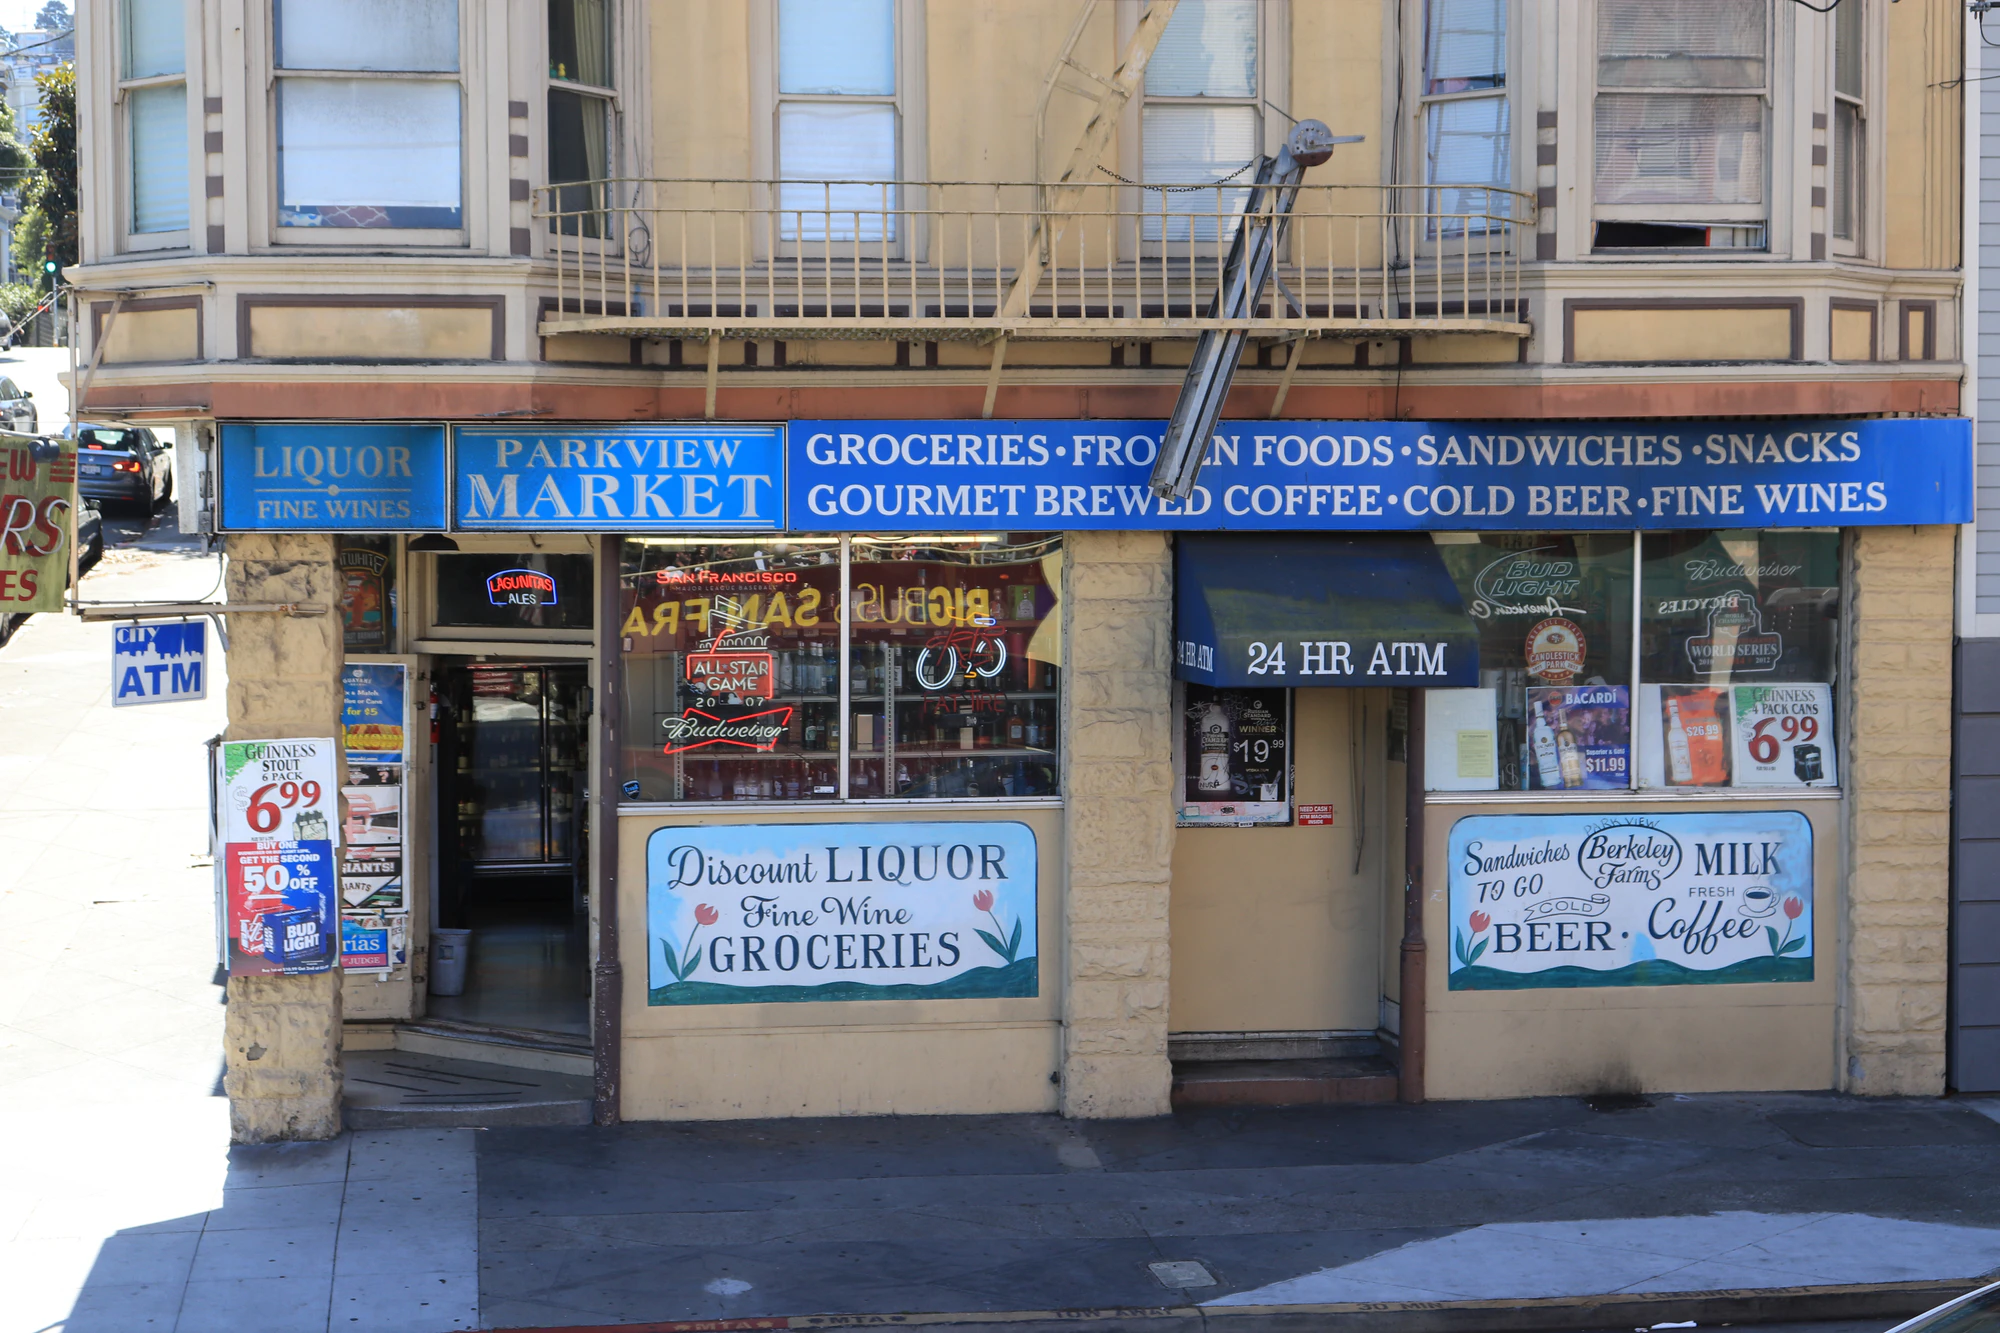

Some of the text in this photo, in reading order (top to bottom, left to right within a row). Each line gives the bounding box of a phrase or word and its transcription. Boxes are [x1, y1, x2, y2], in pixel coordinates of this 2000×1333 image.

[495, 438, 742, 469] PARKVIEW
[806, 431, 1861, 467] GROCERIES FRON FOODS SANDWICHES SNACKS
[254, 445, 413, 486] LIQUOR
[465, 473, 772, 518] MARKET
[807, 481, 1888, 516] GOURMET BREWED COFFEE COLD BEER FINE WINES
[258, 499, 411, 519] FINE WINES
[656, 569, 797, 584] SAN FRANCISCO
[1505, 560, 1574, 580] BUD
[1684, 559, 1803, 581] Budweiser
[489, 575, 553, 592] LAGUNITAS
[1489, 578, 1580, 597] LIGHT
[508, 593, 537, 605] ALES
[116, 626, 160, 645] CITY
[1177, 640, 1213, 672] 24 HR ATM
[1247, 641, 1448, 676] 24 HR ATM
[1530, 651, 1580, 663] CANDLESTICK
[1691, 643, 1778, 657] WORLD SERIES
[693, 660, 769, 675] ALL STAR
[1546, 660, 1566, 669] PARK
[1755, 656, 1771, 664] 2012
[118, 661, 201, 699] ATM
[706, 677, 758, 691] GAME
[695, 696, 764, 708] 20 07
[923, 689, 1005, 713] FAT TIRE
[1565, 688, 1617, 705] BACARDÍ
[1753, 687, 1816, 702] GUINNESS
[347, 706, 379, 716] for $5
[1752, 703, 1819, 715] 4 PACK CANS
[662, 716, 789, 740] Budweiser
[1238, 725, 1277, 733] WINNER
[1686, 724, 1719, 737] $26.99
[245, 743, 317, 760] GUINNESS
[1233, 739, 1285, 763] $19.99
[262, 759, 300, 773] STOUT
[1586, 757, 1626, 773] $11.99
[262, 772, 303, 782] 6 PACK
[1583, 814, 1660, 837] PARK VIEW
[257, 841, 299, 850] BUY ONE
[1586, 834, 1675, 869] Berkeley
[239, 853, 320, 864] GET THE SECOND
[667, 843, 1008, 890] Discount LIQUOR
[1463, 840, 1570, 877] Sandwiches
[1694, 841, 1783, 877] MILK
[289, 876, 319, 890] OFF
[1594, 862, 1662, 891] Farms
[1477, 873, 1543, 904] TO GO
[1689, 885, 1736, 898] FRESH
[740, 895, 914, 928] Fine Wine
[1540, 900, 1593, 914] COLD
[286, 921, 317, 939] BUD
[1648, 897, 1762, 955] Coffee
[283, 932, 320, 953] LIGHT
[348, 956, 381, 965] JUDGE
[709, 931, 961, 973] GROCERIES
[1357, 1302, 1444, 1311] 30 MIN
[696, 1320, 753, 1331] MTA
[828, 1315, 886, 1325] MTA
